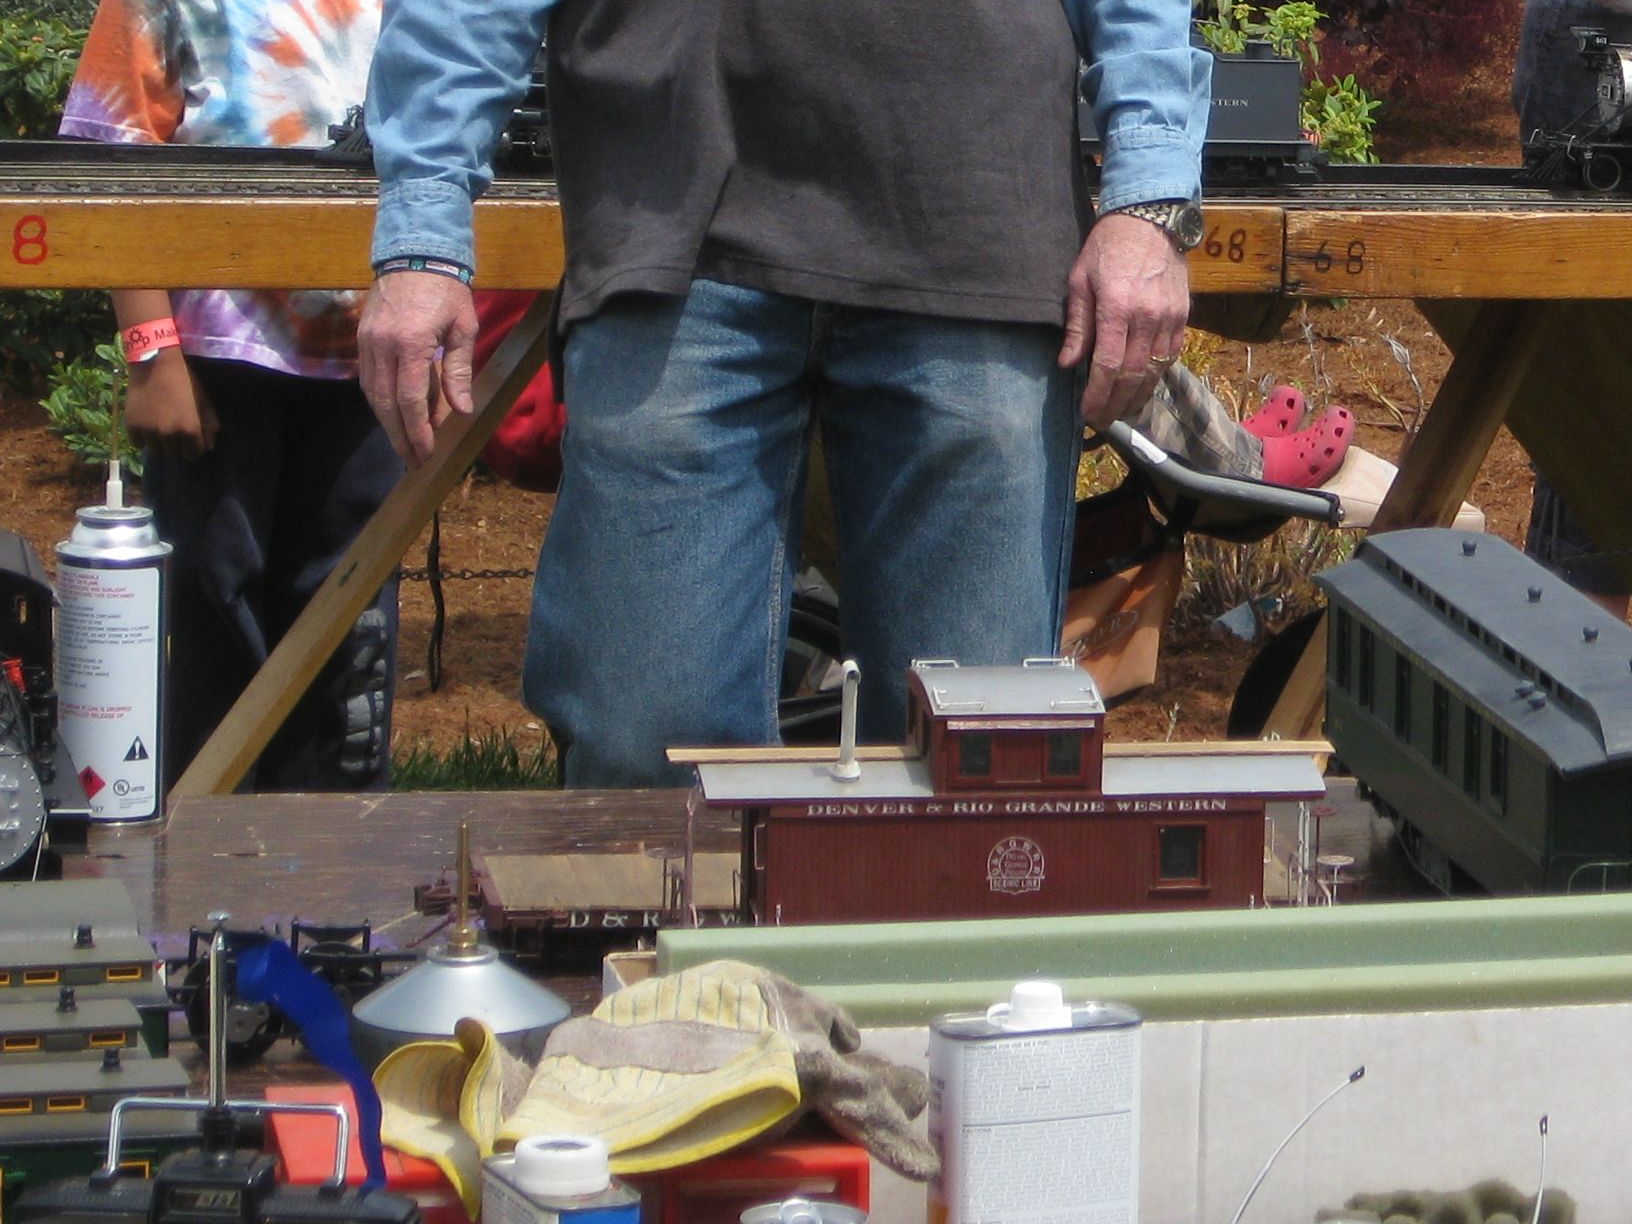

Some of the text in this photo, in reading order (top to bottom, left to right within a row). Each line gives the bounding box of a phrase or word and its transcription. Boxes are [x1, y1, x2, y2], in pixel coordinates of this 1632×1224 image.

[12, 214, 49, 265] 8
[1204, 225, 1247, 264] 68
[1314, 239, 1366, 275] 68
[806, 803, 915, 817] DENVER
[952, 801, 993, 814] RIO
[1005, 800, 1104, 814] GRANDE
[1116, 798, 1227, 812] WESTERN
